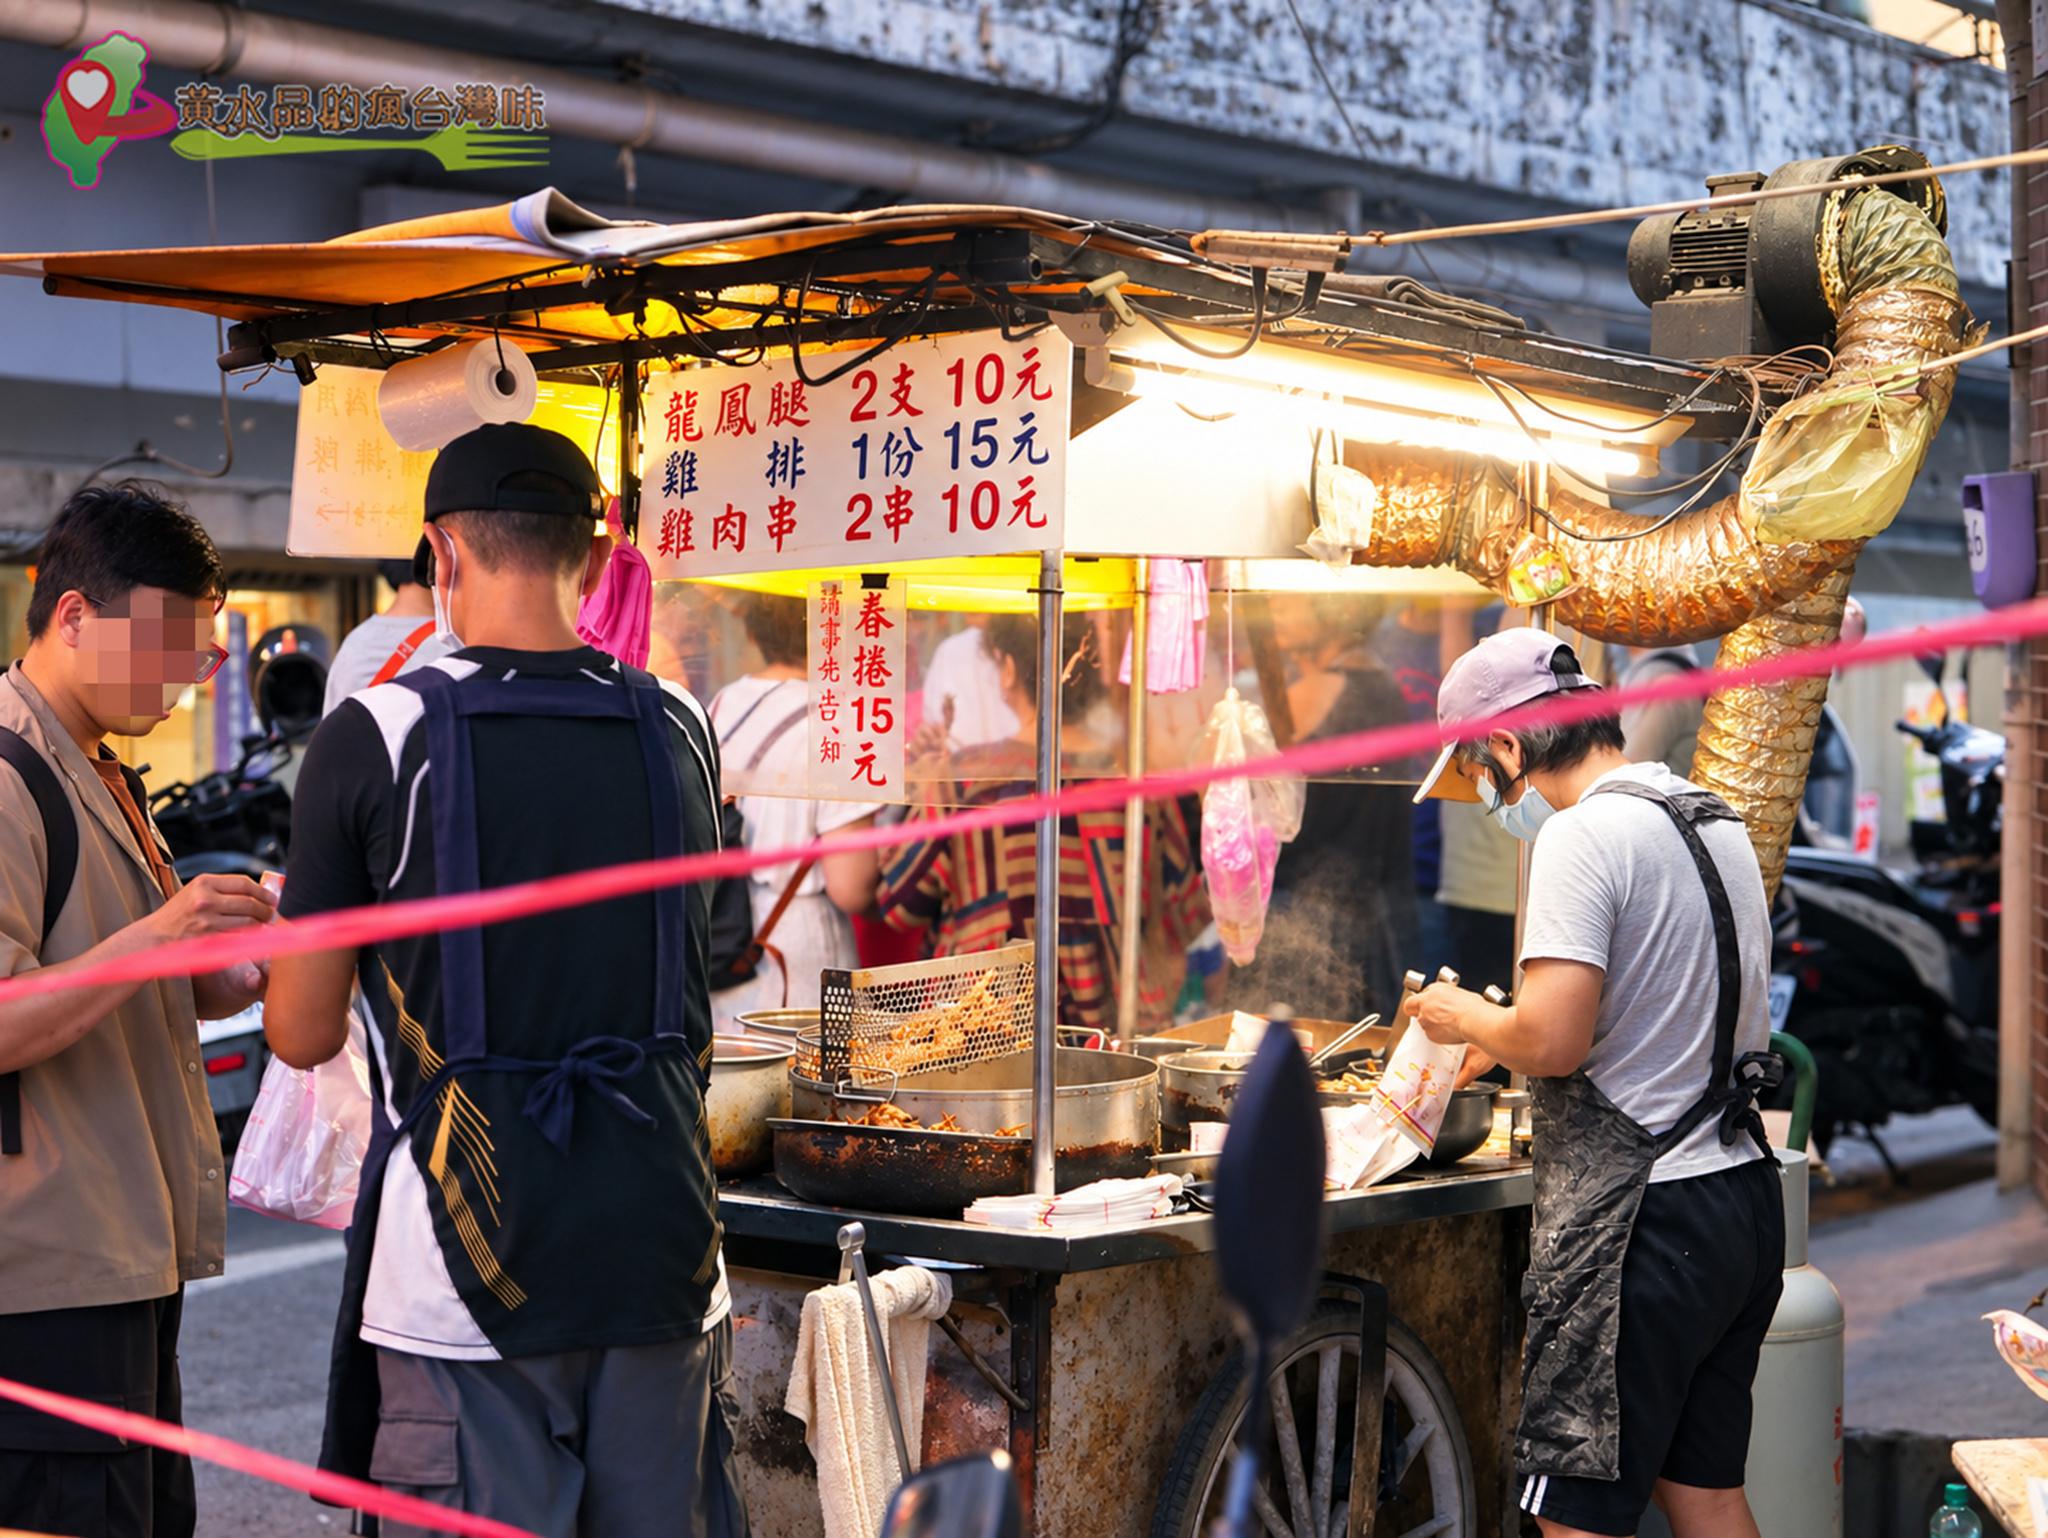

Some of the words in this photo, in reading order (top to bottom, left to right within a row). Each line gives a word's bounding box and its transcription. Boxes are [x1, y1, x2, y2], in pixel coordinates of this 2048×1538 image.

[664, 379, 811, 443] 龍鳳腿
[849, 362, 924, 423] 2支
[946, 346, 1053, 408] 10元
[851, 426, 923, 480] 1份
[944, 412, 1049, 470] 15元
[657, 494, 799, 560] 雞肉串
[845, 484, 915, 544] 2串
[941, 475, 1048, 534] 10元
[850, 591, 895, 787] 春捲15元
